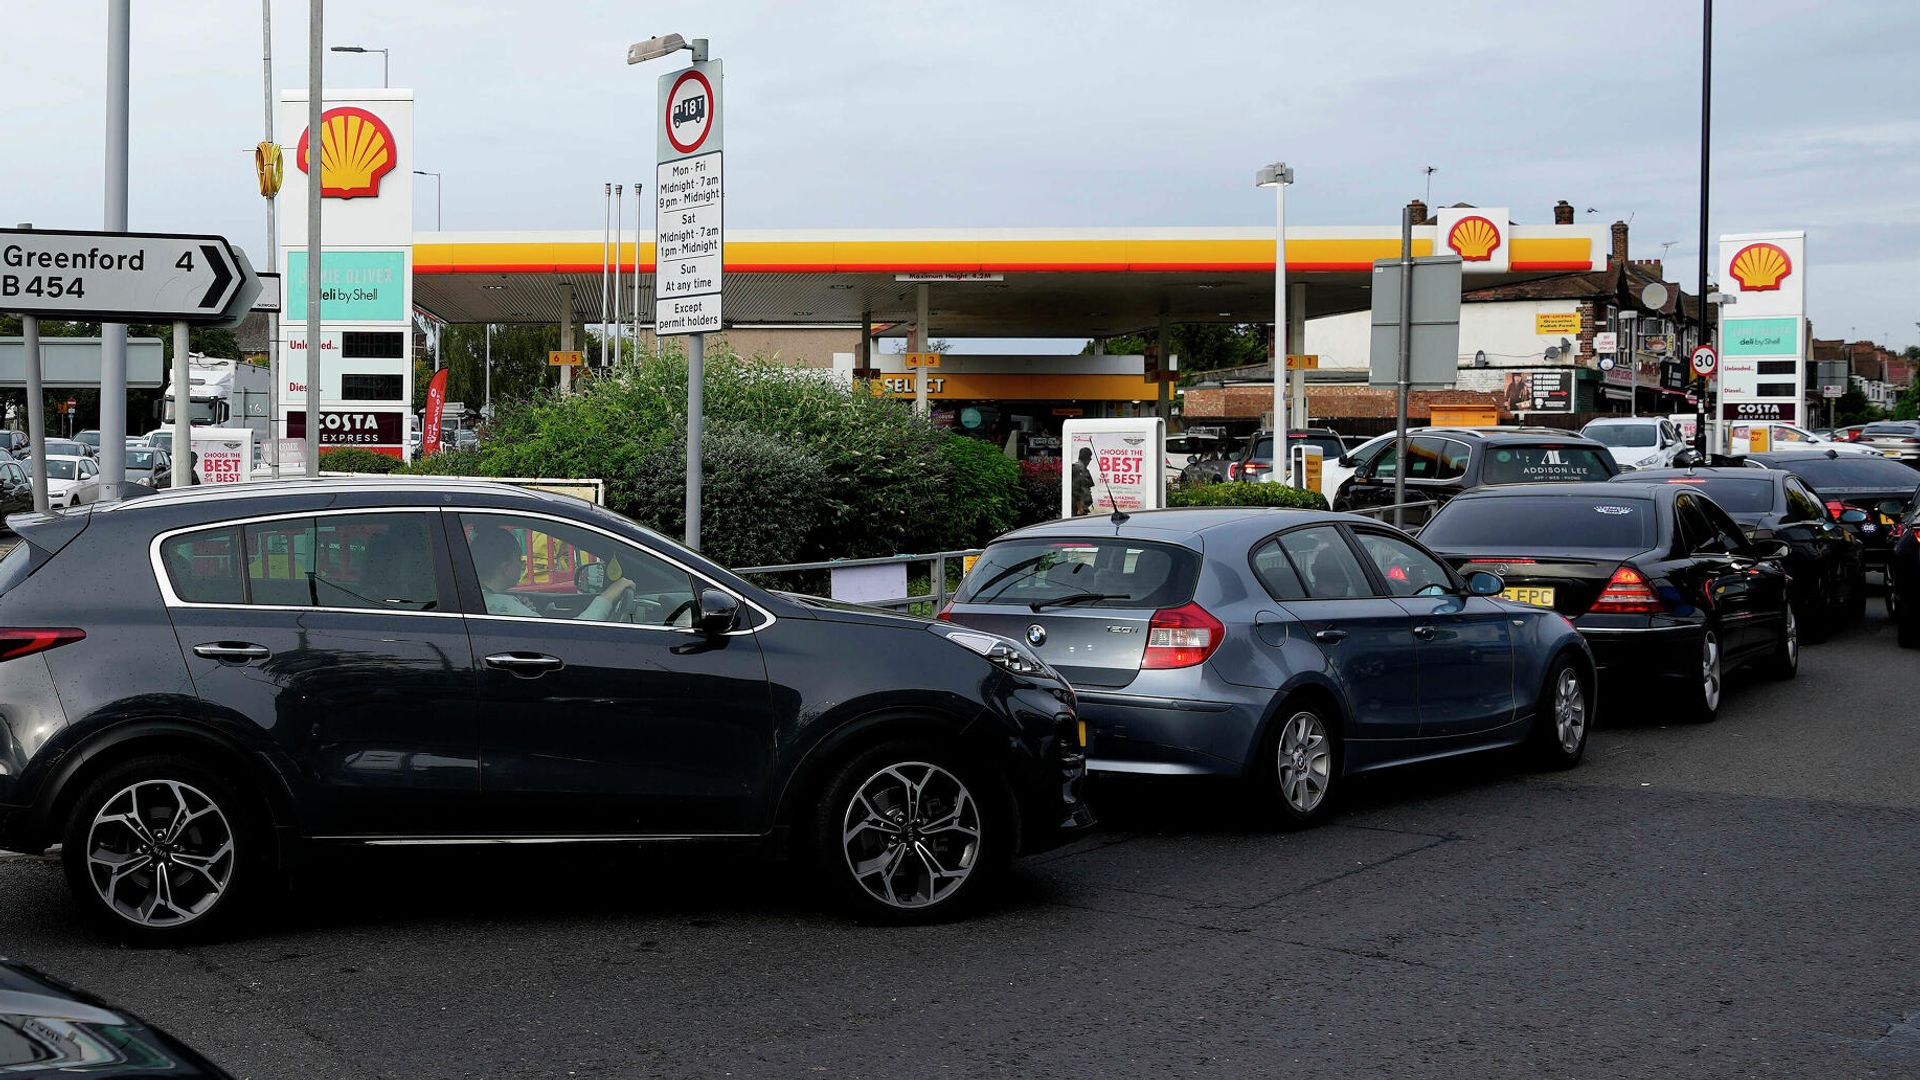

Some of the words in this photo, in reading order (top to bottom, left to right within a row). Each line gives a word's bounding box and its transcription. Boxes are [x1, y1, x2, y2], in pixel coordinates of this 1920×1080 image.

[672, 166, 689, 177] Mon
[695, 161, 706, 172] Fri
[660, 180, 695, 194] Midnight
[684, 189, 720, 204] Midnight
[682, 213, 696, 225] Sat
[660, 229, 695, 243] Midnight
[682, 240, 718, 254] Midnight
[3, 245, 144, 271] Greenford
[175, 251, 195, 272] 4
[681, 264, 697, 275] Sun
[666, 281, 675, 292] At
[677, 280, 691, 292] any
[694, 278, 712, 289] time
[320, 288, 336, 301] eli
[338, 288, 352, 303] by
[353, 288, 378, 301] Shell
[674, 301, 703, 314] Except
[659, 317, 685, 331] permit
[687, 314, 718, 326] holders
[290, 340, 332, 350] Unled
[1739, 338, 1754, 346] deli
[1765, 337, 1780, 345] Shell
[553, 354, 560, 363] 6
[571, 354, 577, 363] 5
[910, 356, 917, 364] 4
[928, 356, 935, 364] 3
[1286, 357, 1293, 366] 2
[1307, 357, 1312, 366] 1
[1695, 354, 1714, 368] 30
[289, 382, 308, 392] Dies
[884, 378, 945, 393] SELCT
[1737, 404, 1780, 415] COSTA
[322, 434, 379, 442] EXPRESS
[263, 442, 299, 451] WCOME
[1100, 448, 1128, 456] CHOOSE
[203, 459, 241, 472] BEST
[1099, 457, 1143, 473] BEST
[1523, 466, 1568, 474] ADDISON
[216, 473, 241, 482] BEST
[1113, 473, 1142, 484] BEST
[1517, 590, 1552, 605] EPC
